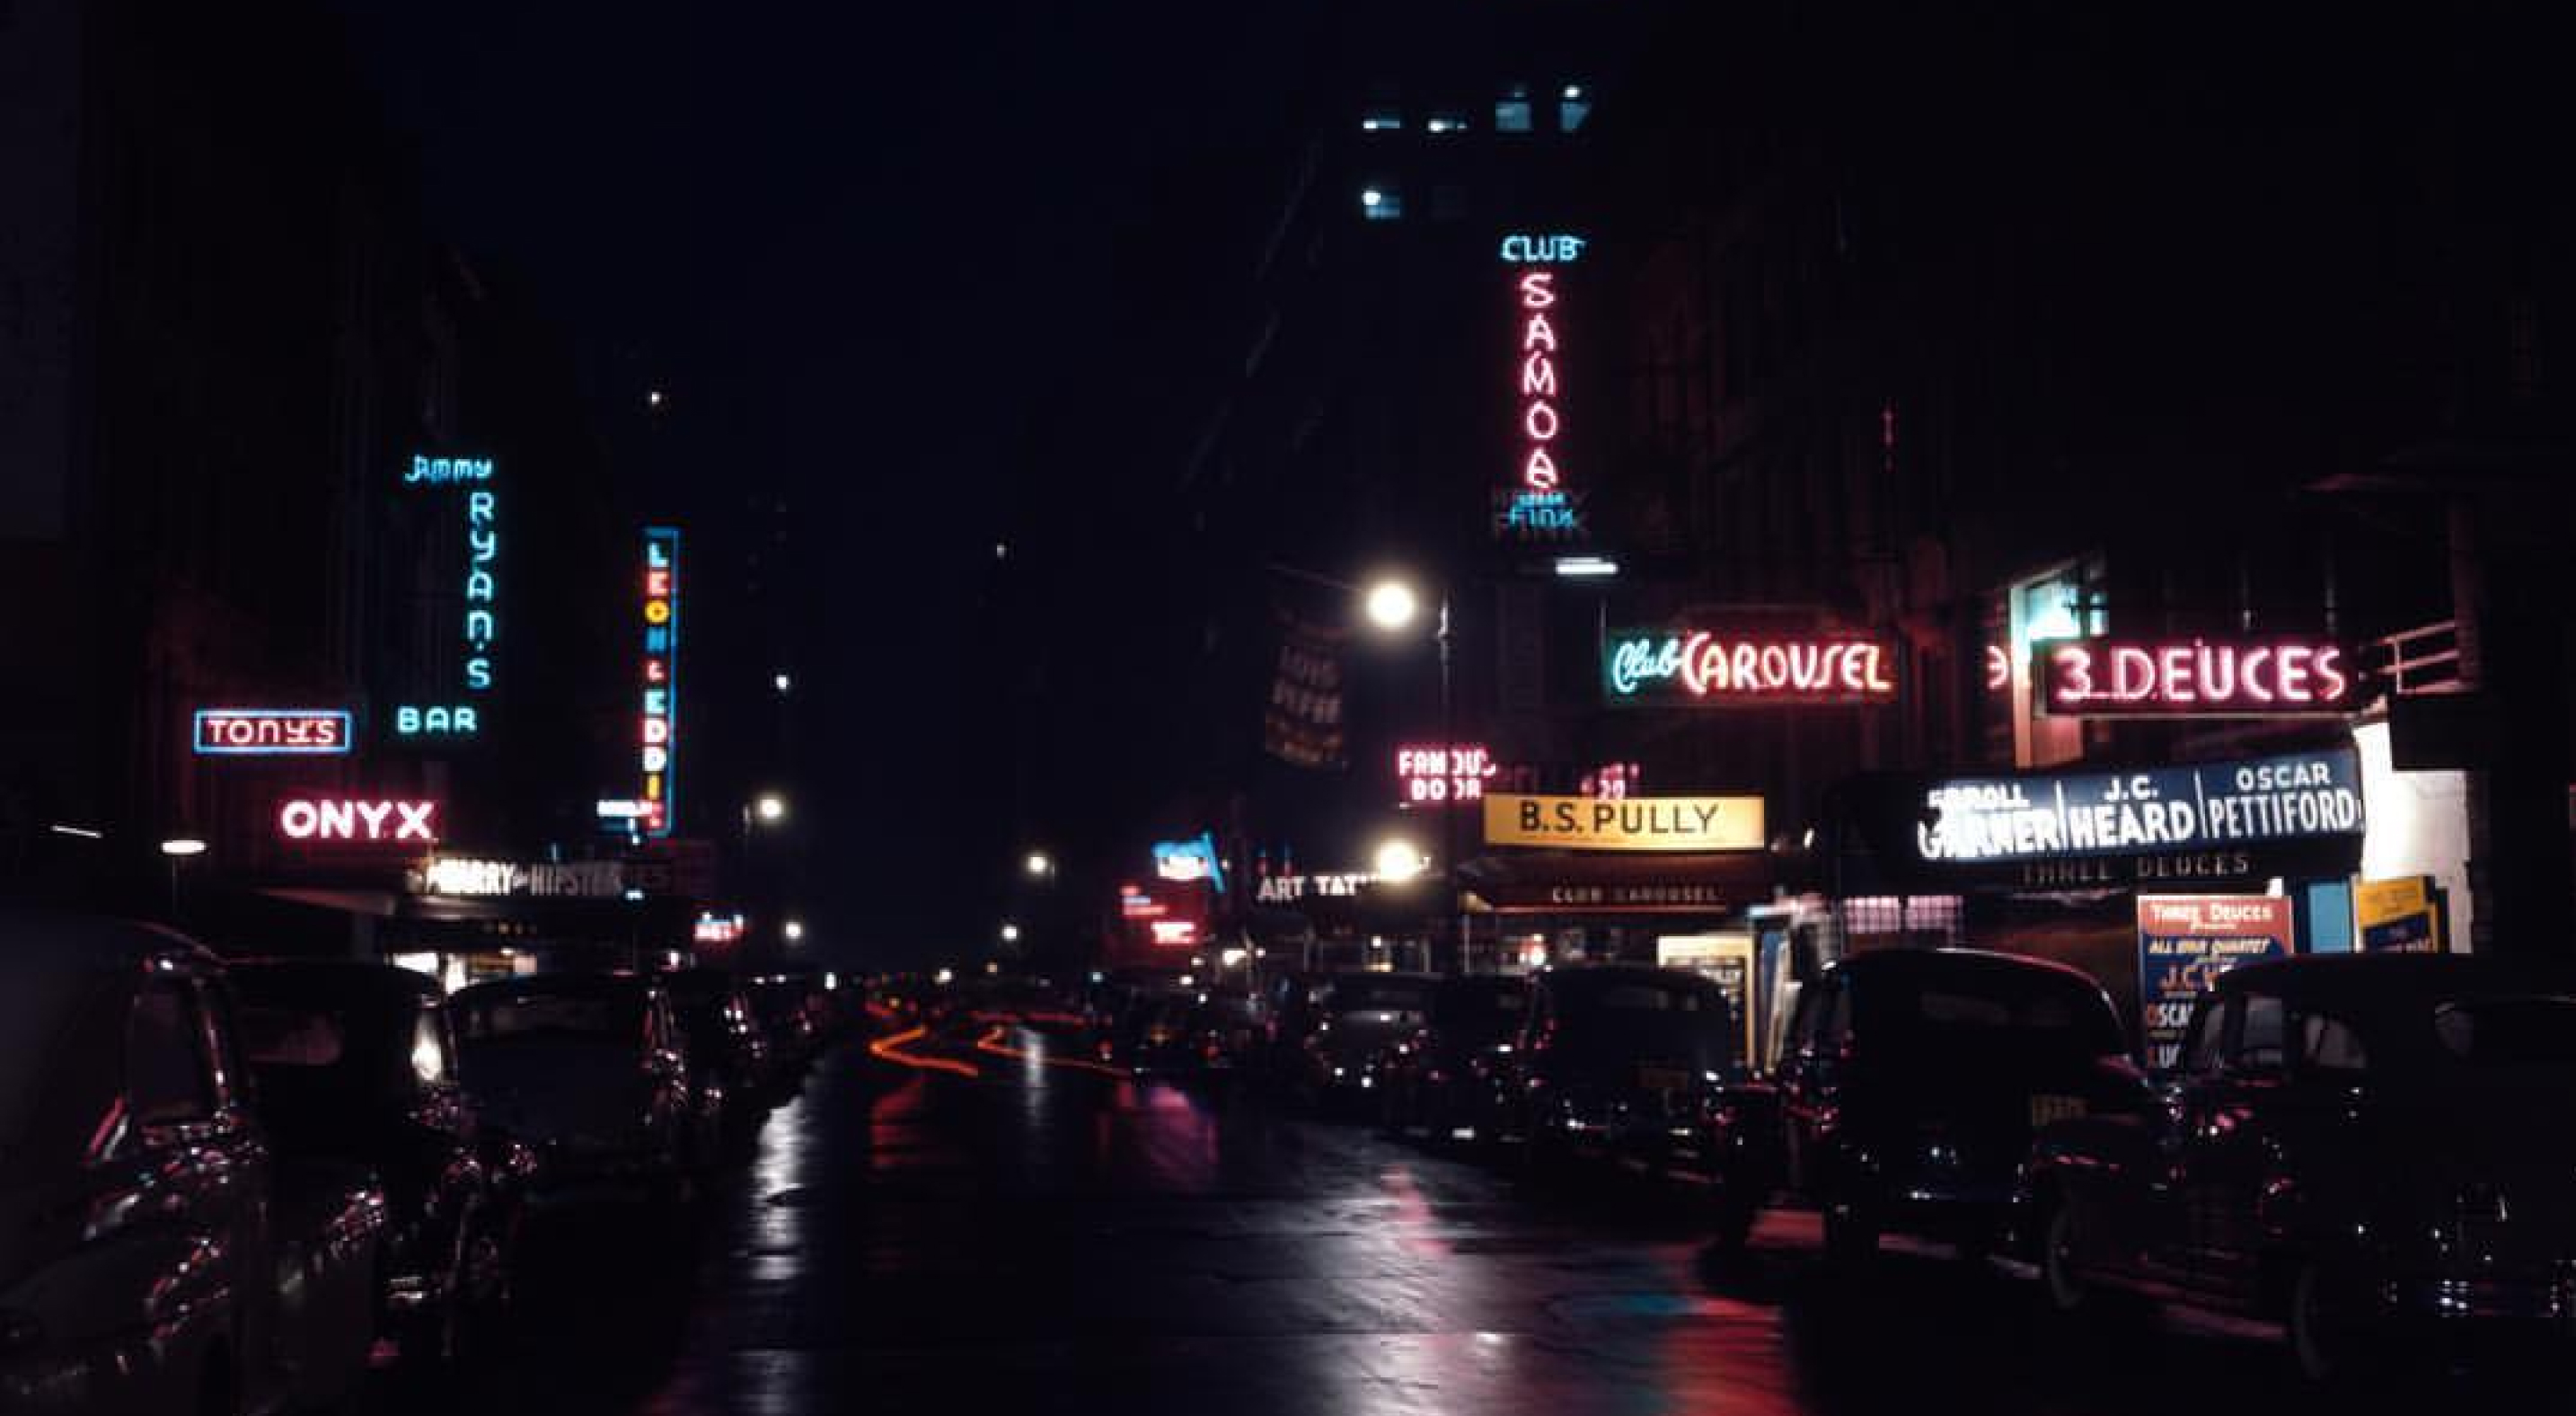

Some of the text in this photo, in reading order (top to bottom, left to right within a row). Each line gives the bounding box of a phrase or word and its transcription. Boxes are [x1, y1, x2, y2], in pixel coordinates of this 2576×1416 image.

[1500, 235, 1587, 262] CLUB
[1519, 271, 1558, 489] SAMOA
[1613, 629, 1893, 696] Club CAROUSEL
[2055, 646, 2092, 701] 3
[2111, 643, 2347, 702] DEUCES
[397, 706, 479, 733] BAR
[2103, 774, 2158, 801] J.C.
[2236, 762, 2331, 792] OSCAR
[279, 799, 436, 839] ONYX
[1519, 800, 1719, 835] B.S. PULLY
[2068, 799, 2195, 849] HEARD
[2209, 786, 2355, 839] PETTIFORD
[1256, 874, 1305, 902] ART
